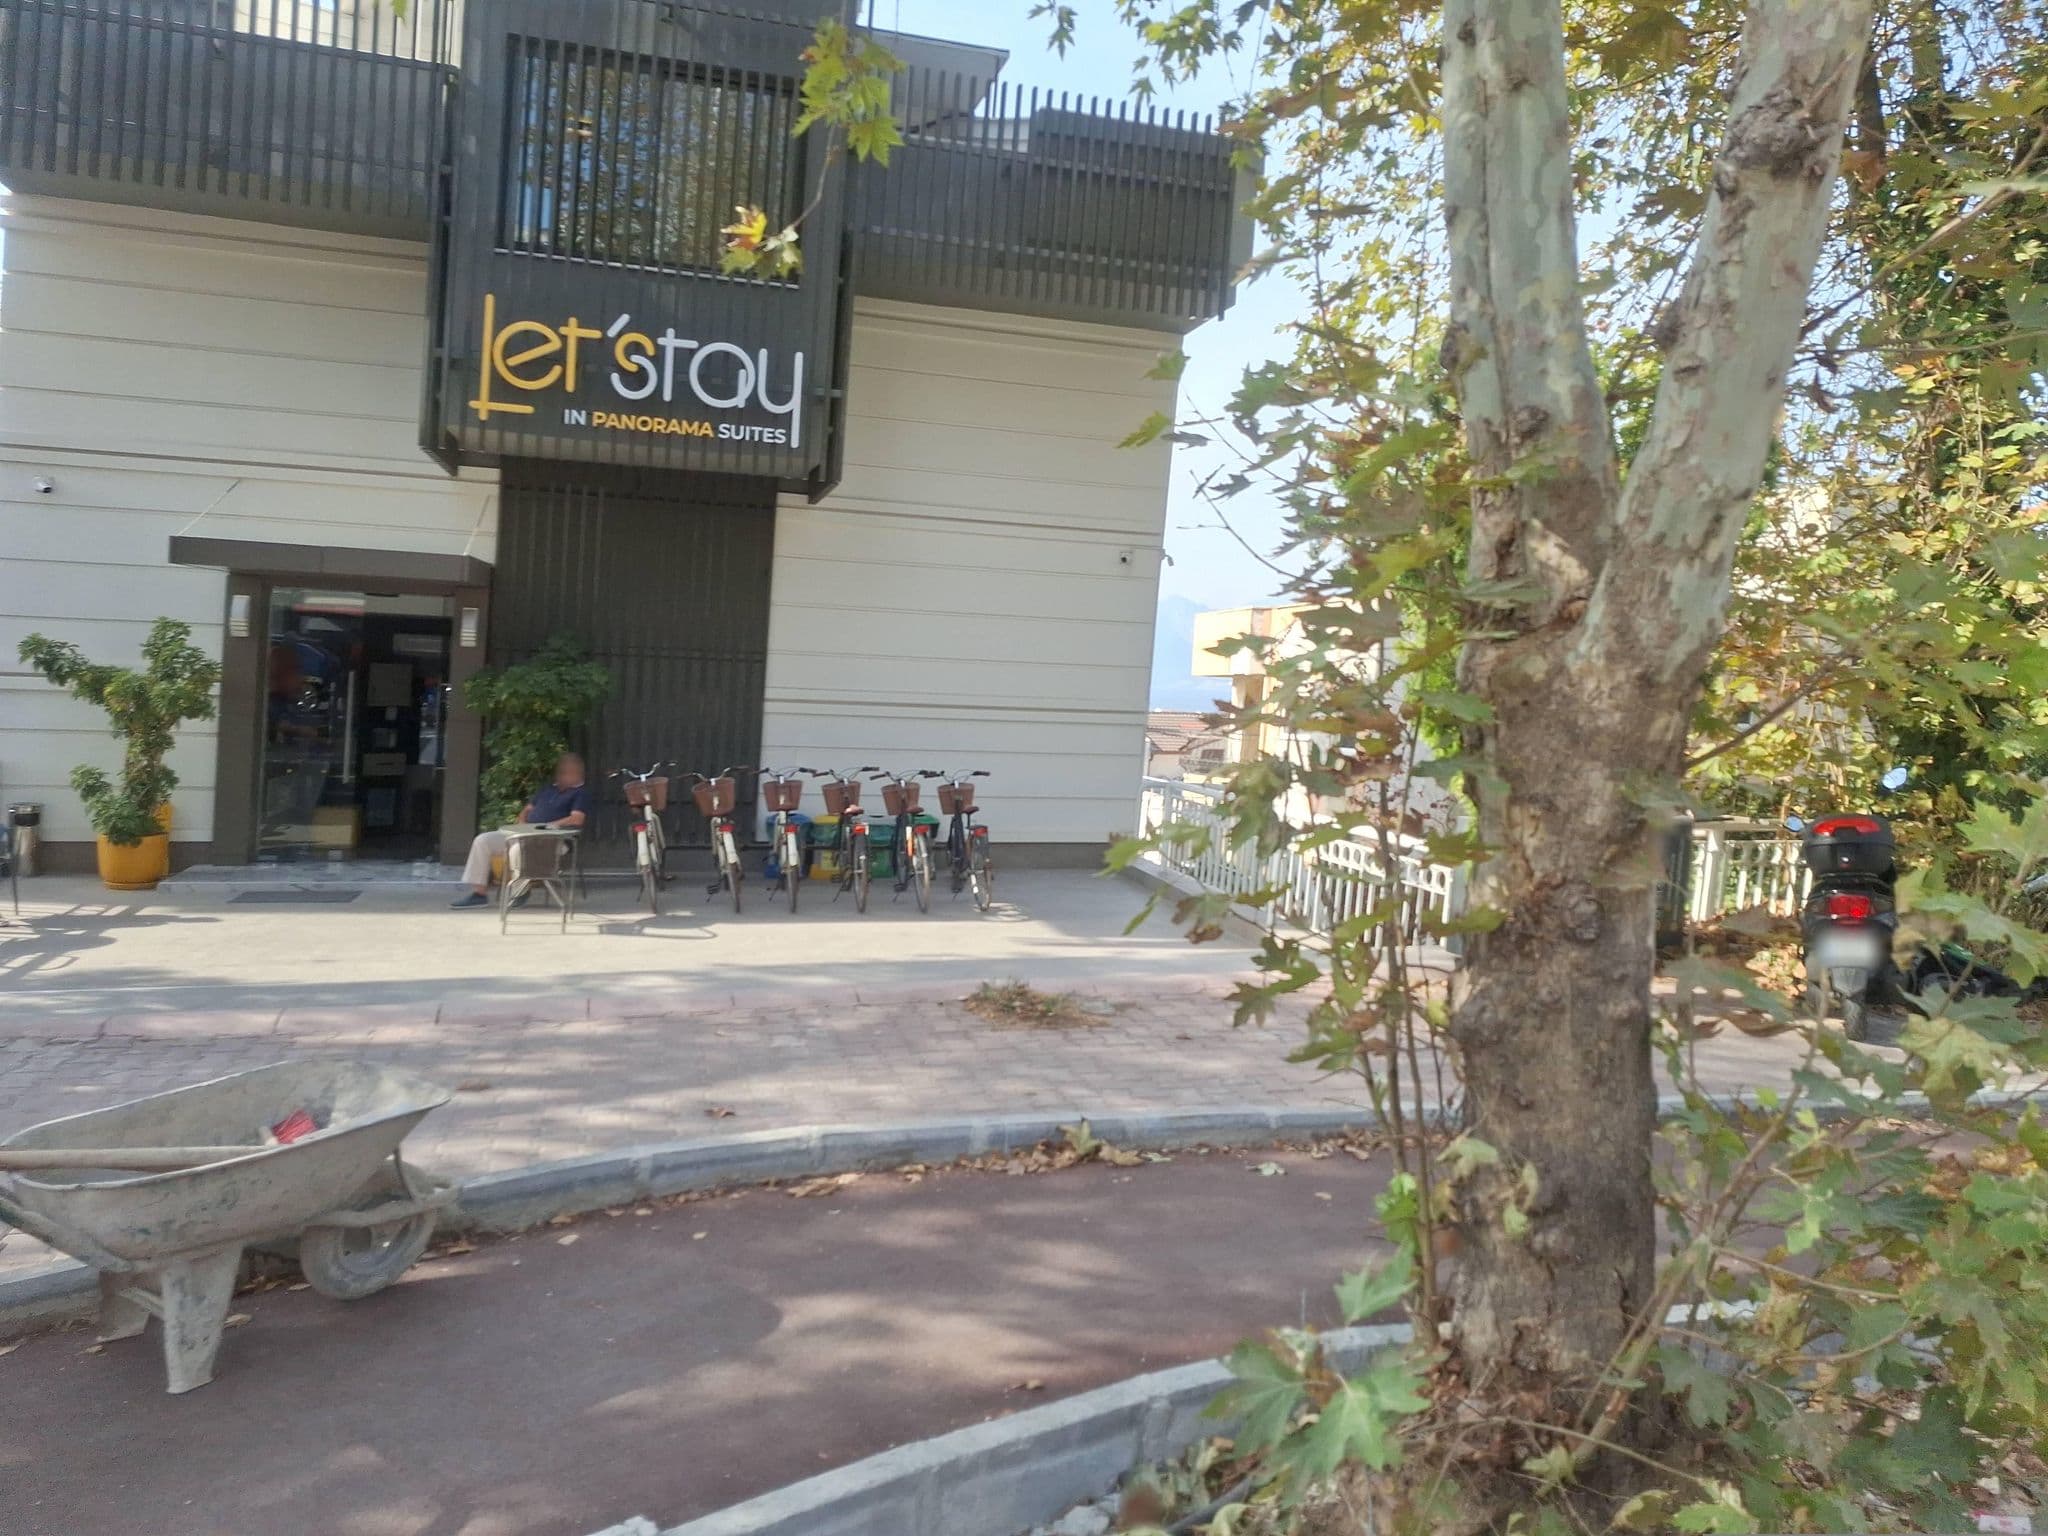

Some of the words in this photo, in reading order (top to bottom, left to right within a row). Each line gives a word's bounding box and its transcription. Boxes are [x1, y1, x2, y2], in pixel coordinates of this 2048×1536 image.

[564, 408, 587, 426] IN
[592, 410, 714, 438] PANORAMA
[718, 423, 787, 445] SUITES
